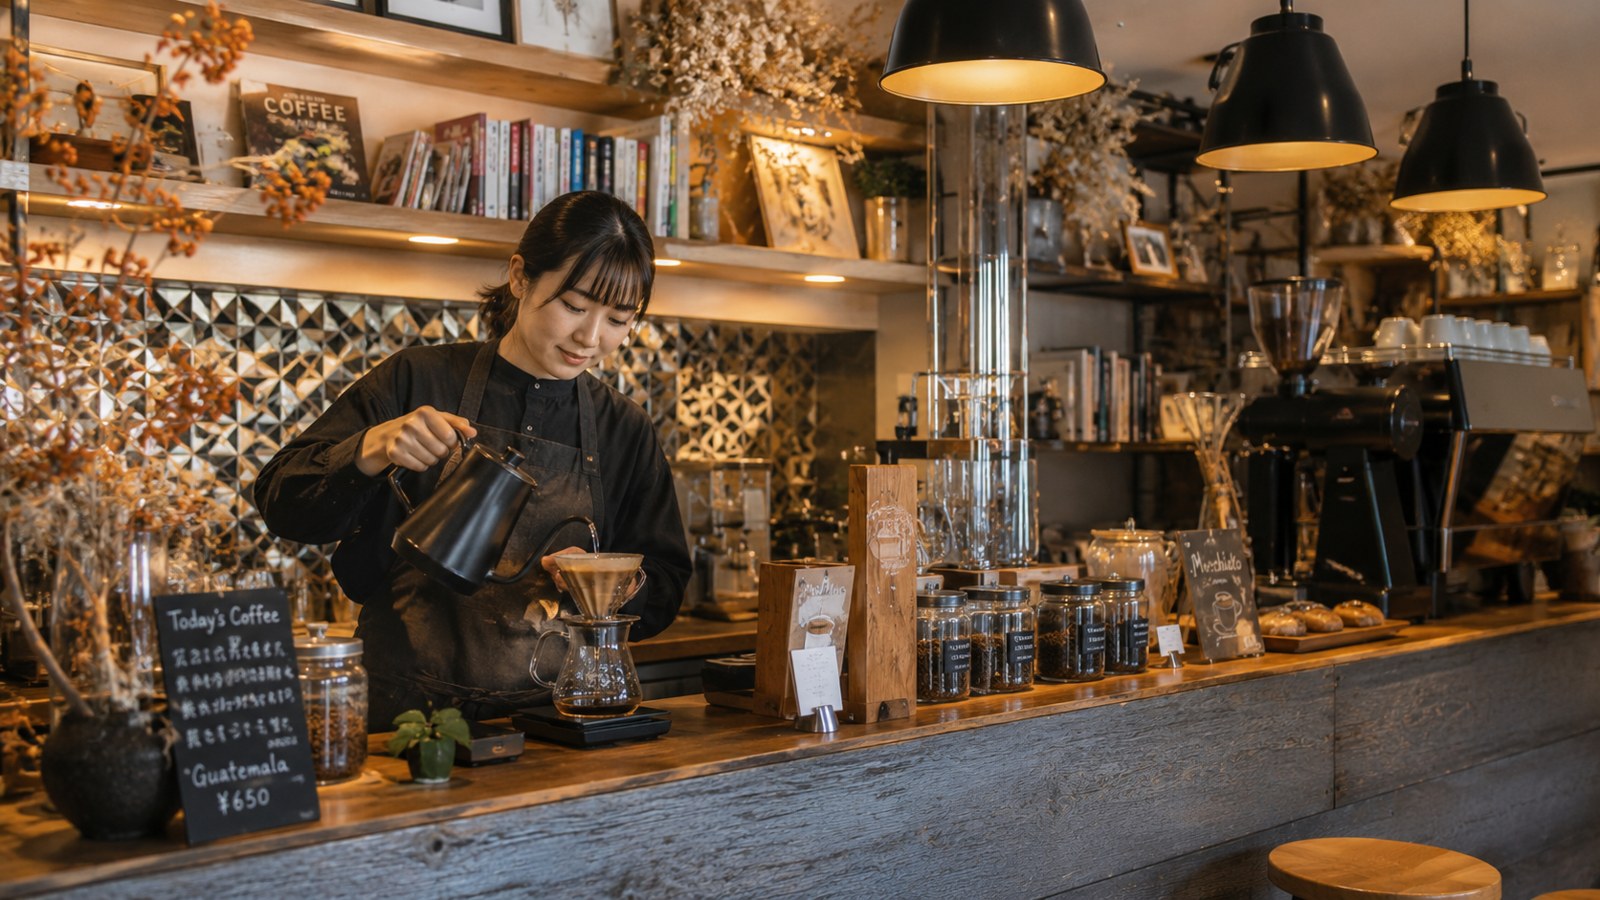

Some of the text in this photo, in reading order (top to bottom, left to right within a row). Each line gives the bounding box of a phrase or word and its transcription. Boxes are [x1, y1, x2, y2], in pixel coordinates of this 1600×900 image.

[263, 97, 346, 123] COFFEE
[166, 604, 281, 635] Today's Coffee
[191, 752, 290, 788] Guatemala
[217, 788, 270, 815] ¥650
